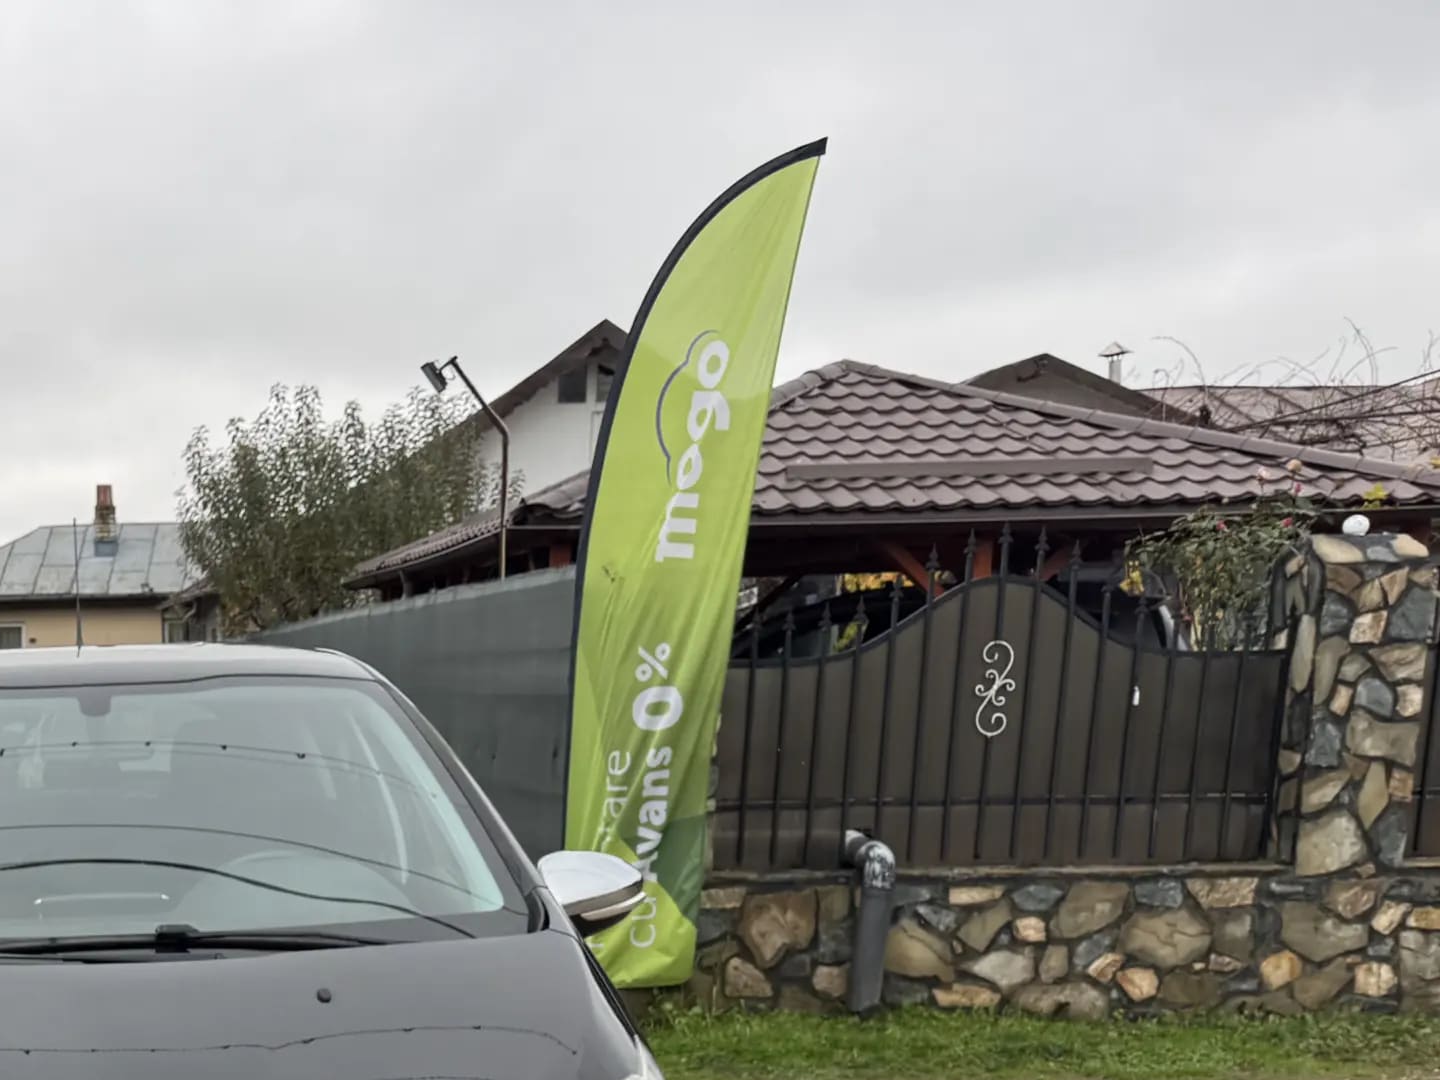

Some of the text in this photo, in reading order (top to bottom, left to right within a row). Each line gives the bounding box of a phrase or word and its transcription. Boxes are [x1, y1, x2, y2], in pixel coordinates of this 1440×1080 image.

[655, 340, 730, 562] mogo
[632, 642, 684, 733] 0%
[632, 745, 672, 882] Avans
